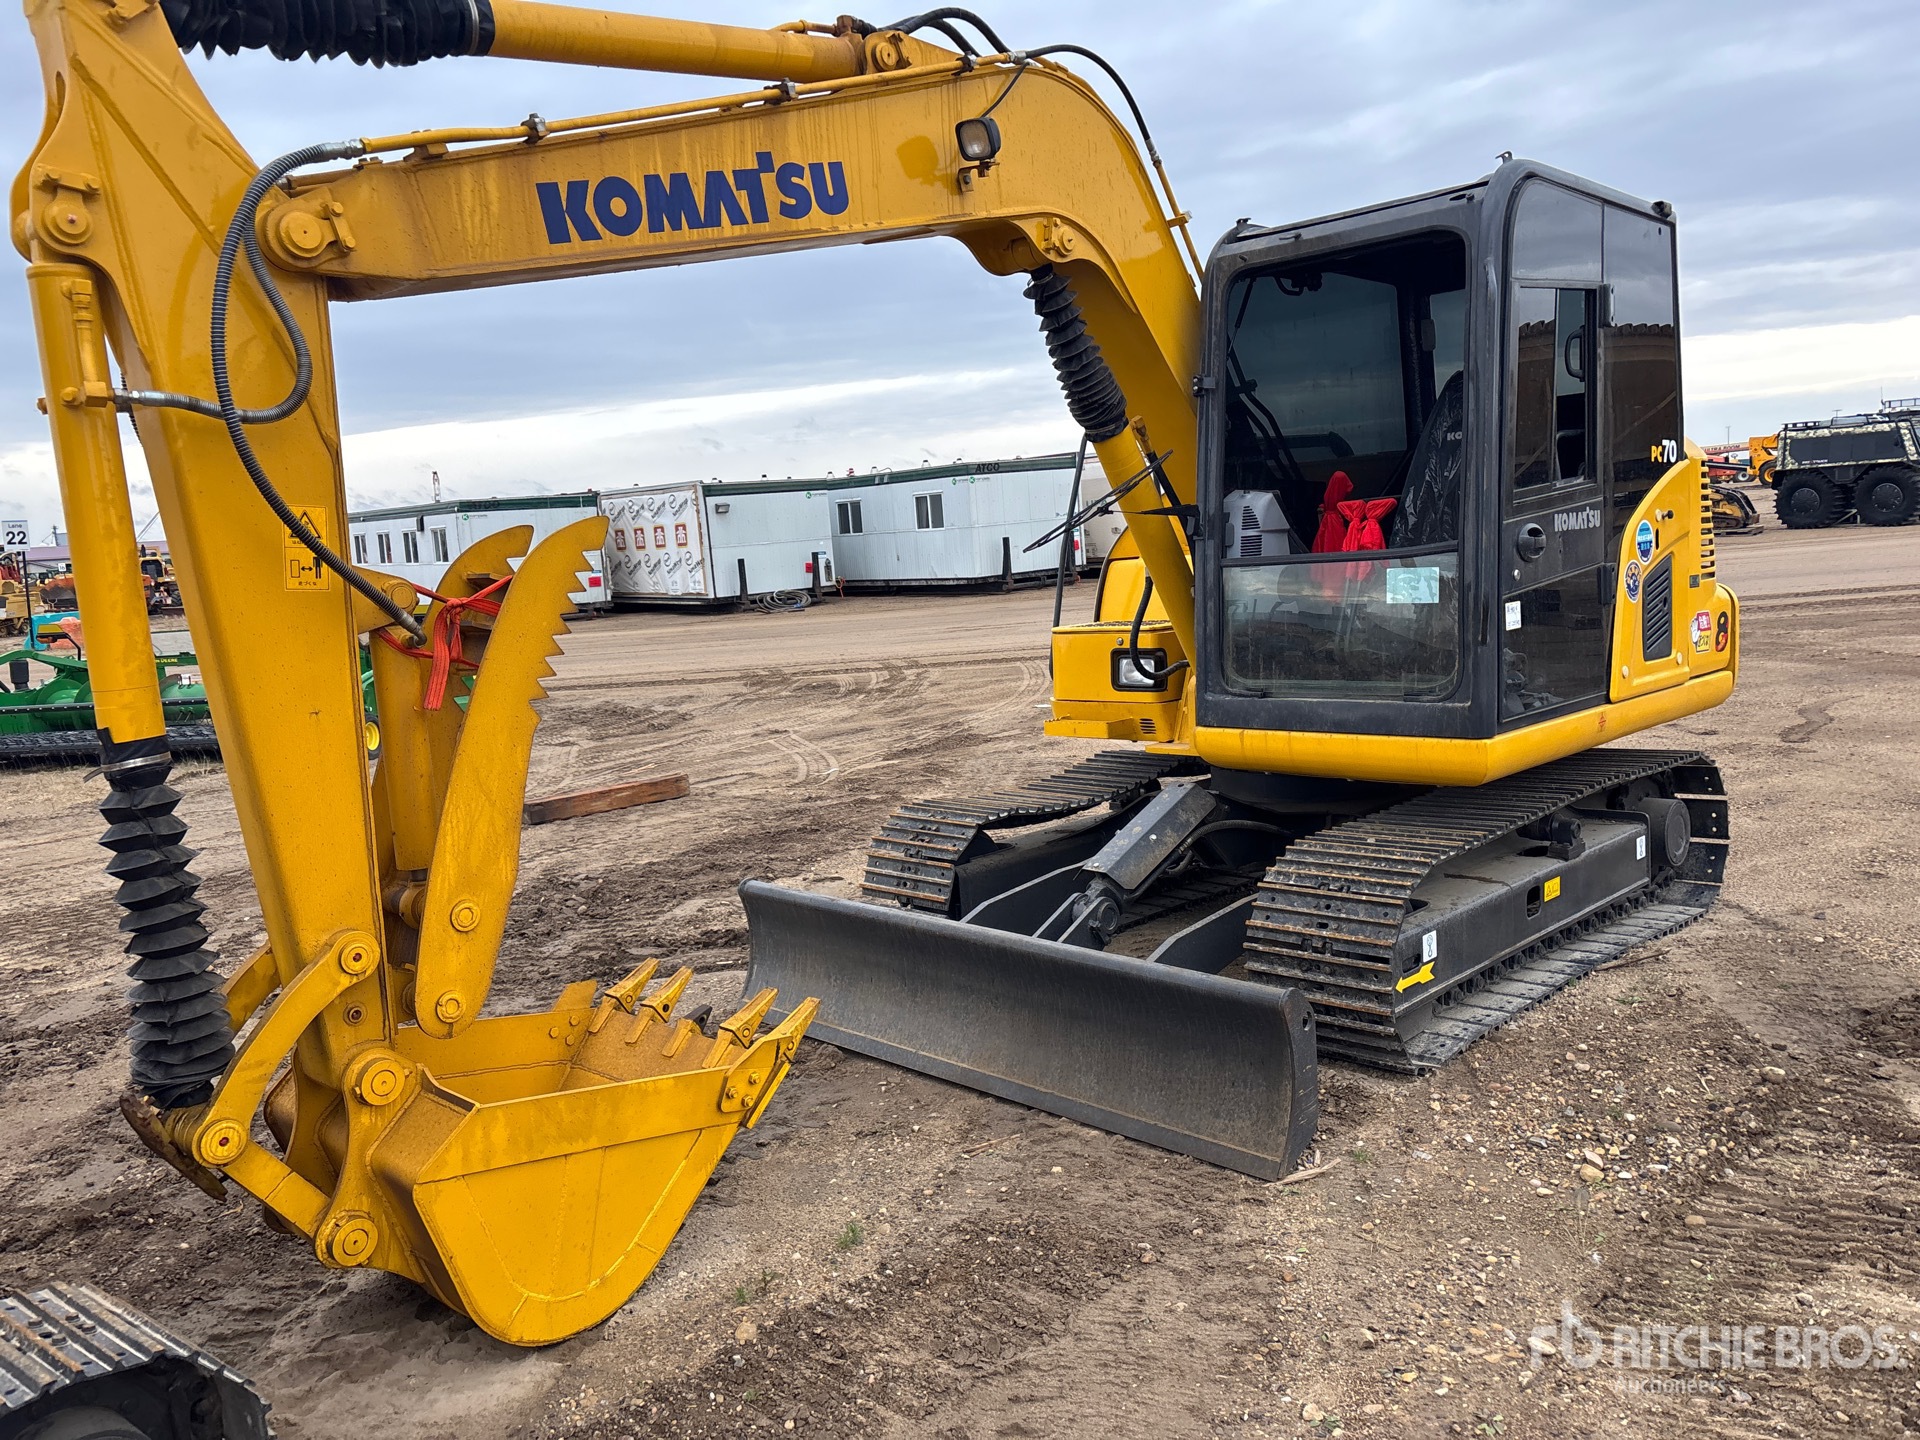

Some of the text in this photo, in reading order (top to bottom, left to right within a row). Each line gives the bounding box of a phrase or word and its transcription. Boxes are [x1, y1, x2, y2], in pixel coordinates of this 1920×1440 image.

[535, 151, 849, 245] KOMATSU
[1651, 439, 1677, 463] PC70
[974, 462, 1000, 473] ATCO
[1554, 506, 1601, 532] KOMATSU
[5, 530, 28, 545] 22
